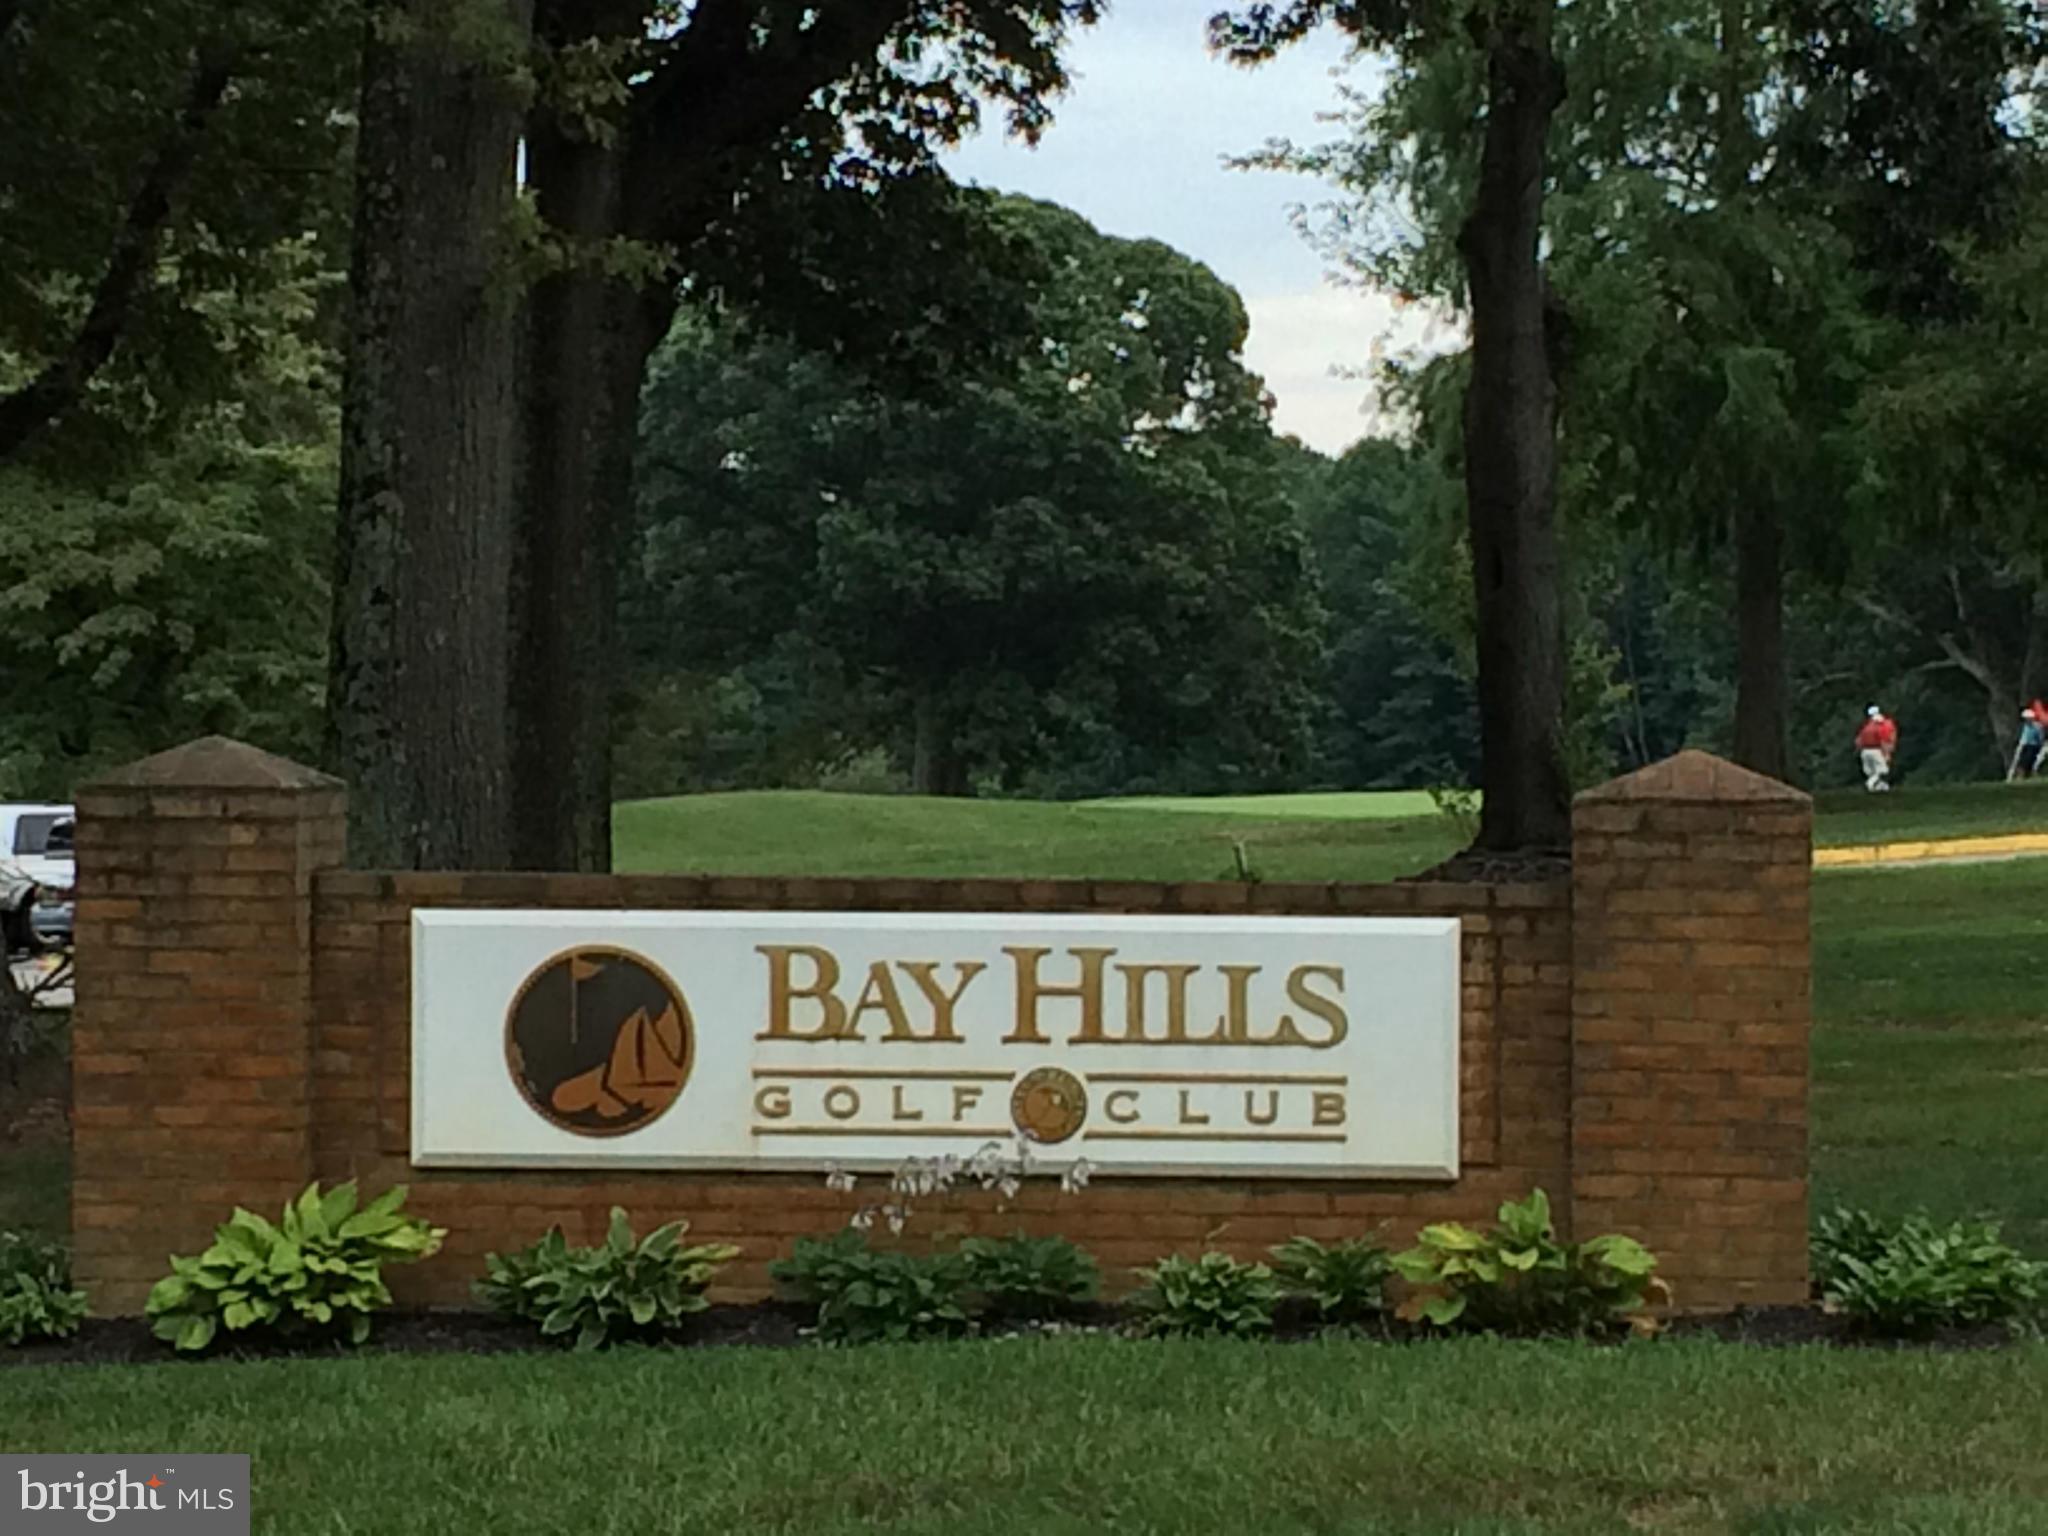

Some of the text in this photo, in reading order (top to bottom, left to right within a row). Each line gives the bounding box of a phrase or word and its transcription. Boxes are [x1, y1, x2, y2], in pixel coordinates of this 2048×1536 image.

[754, 944, 1349, 1049] BAY HILLS
[754, 1086, 984, 1121] GOLF
[1103, 1089, 1348, 1126] CLUB
